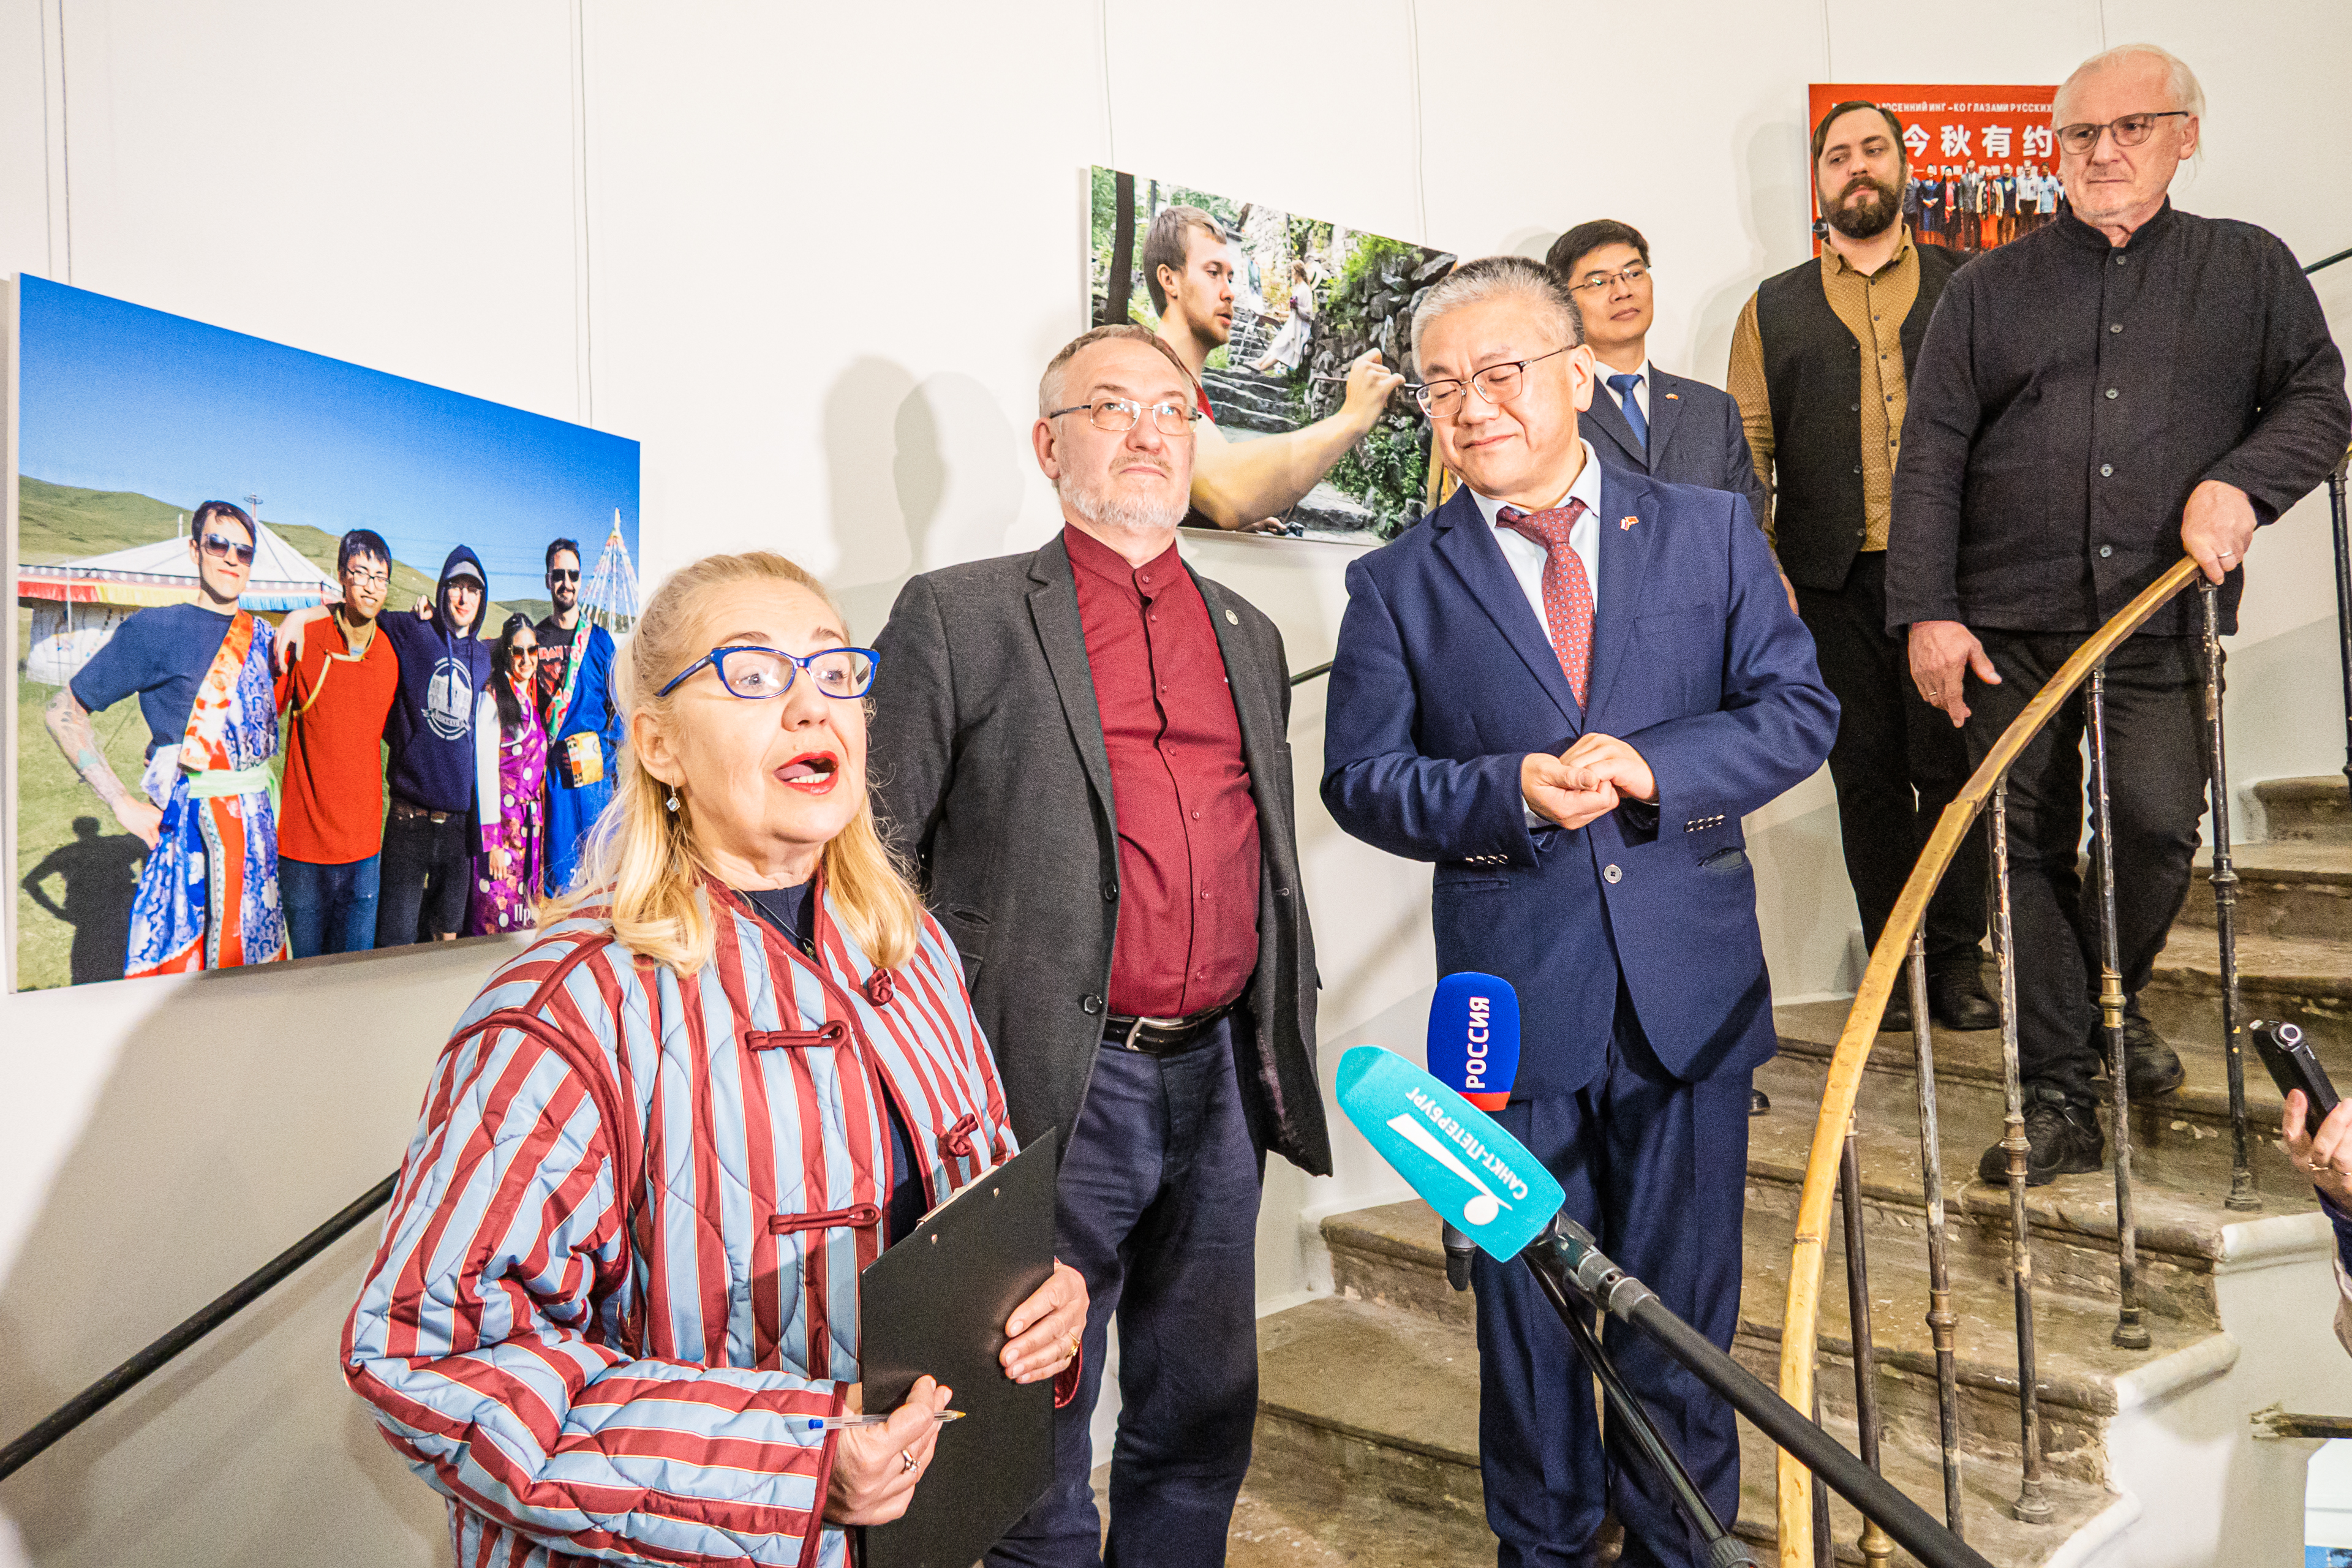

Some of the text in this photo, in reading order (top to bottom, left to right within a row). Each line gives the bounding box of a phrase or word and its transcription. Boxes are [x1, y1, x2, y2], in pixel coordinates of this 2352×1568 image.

[1967, 102, 2008, 112] ГЛАЗАМИ
[2010, 102, 2052, 113] РУССКИХ
[1466, 996, 1490, 1088] РОССИЯ
[1405, 1087, 1528, 1200] САНКТ-ПЕТЕРБУРГ
